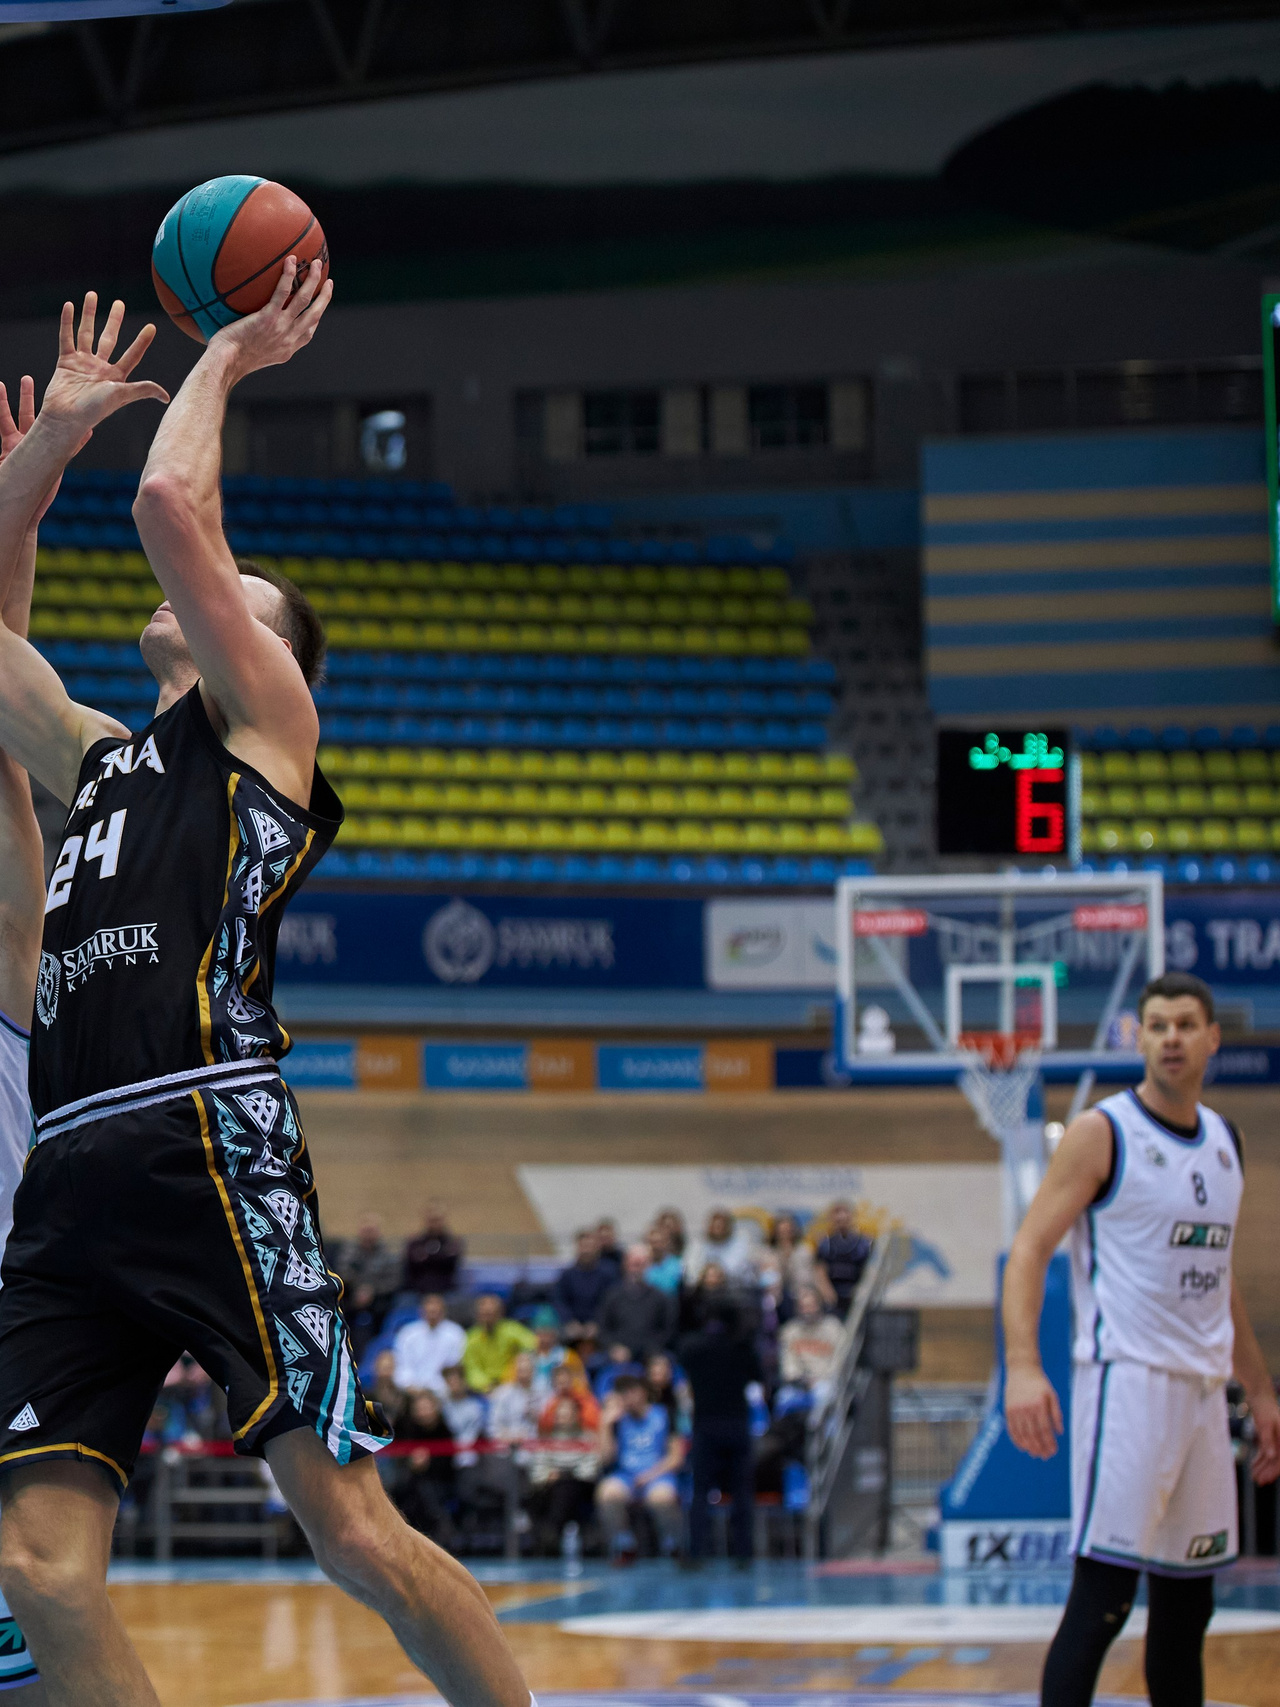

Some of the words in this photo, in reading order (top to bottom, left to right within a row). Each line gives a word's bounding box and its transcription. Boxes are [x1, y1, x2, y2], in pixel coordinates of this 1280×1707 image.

[1016, 768, 1065, 853] 6
[45, 808, 128, 916] 24
[63, 926, 159, 976] SAMRUK
[67, 952, 160, 993] KAZYNA
[1191, 1171, 1208, 1206] 8
